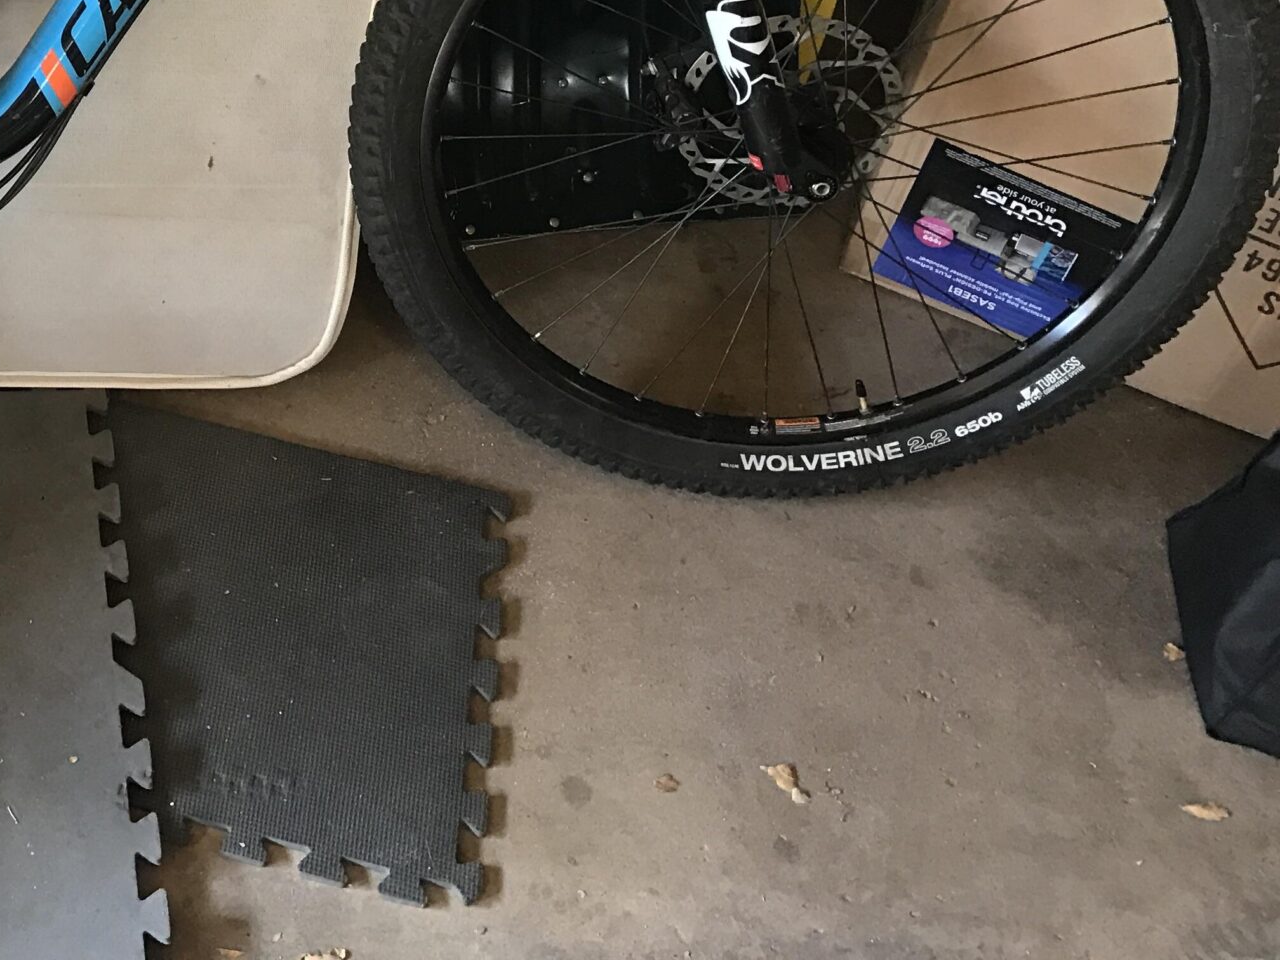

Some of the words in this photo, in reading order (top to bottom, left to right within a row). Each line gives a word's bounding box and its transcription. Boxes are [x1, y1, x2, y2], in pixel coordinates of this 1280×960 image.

[996, 183, 1020, 199] side
[1017, 190, 1044, 207] your
[973, 187, 1067, 238] brother
[1044, 203, 1057, 214] at
[948, 283, 996, 312] SASEB1
[1036, 355, 1081, 390] TUBELESS
[740, 441, 904, 472] WOLVERINE
[907, 429, 951, 454] 2.2
[954, 410, 1003, 438] 650b
